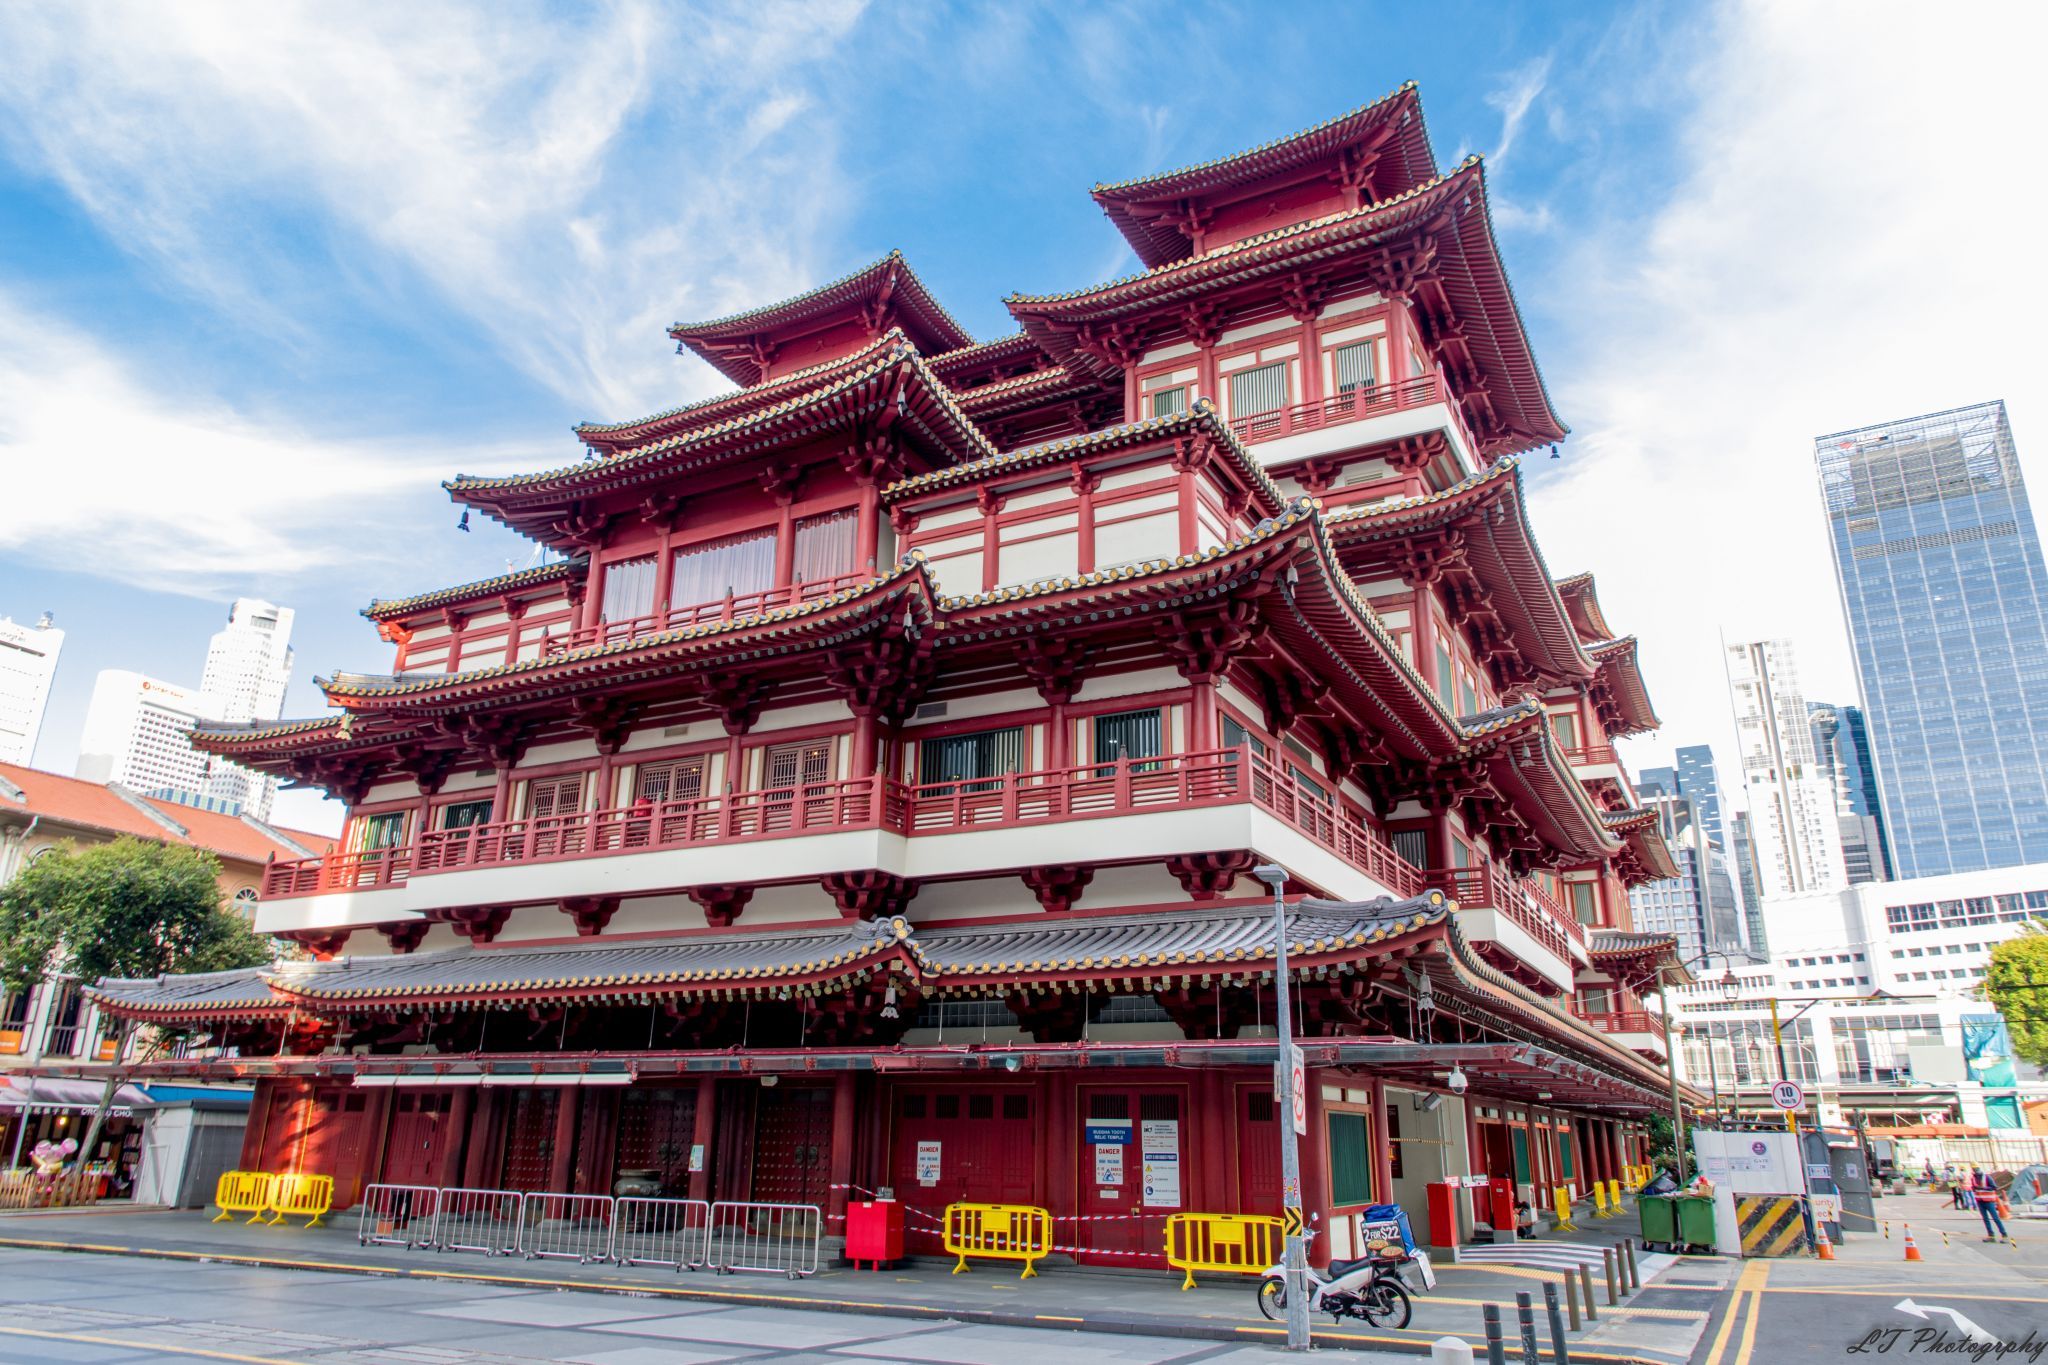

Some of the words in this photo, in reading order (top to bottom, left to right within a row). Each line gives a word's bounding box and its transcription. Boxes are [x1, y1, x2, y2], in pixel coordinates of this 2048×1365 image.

[1780, 1086, 1793, 1097] 10
[1363, 1229, 1371, 1242] 2
[1371, 1231, 1380, 1239] FOR
[1380, 1226, 1401, 1240] $22
